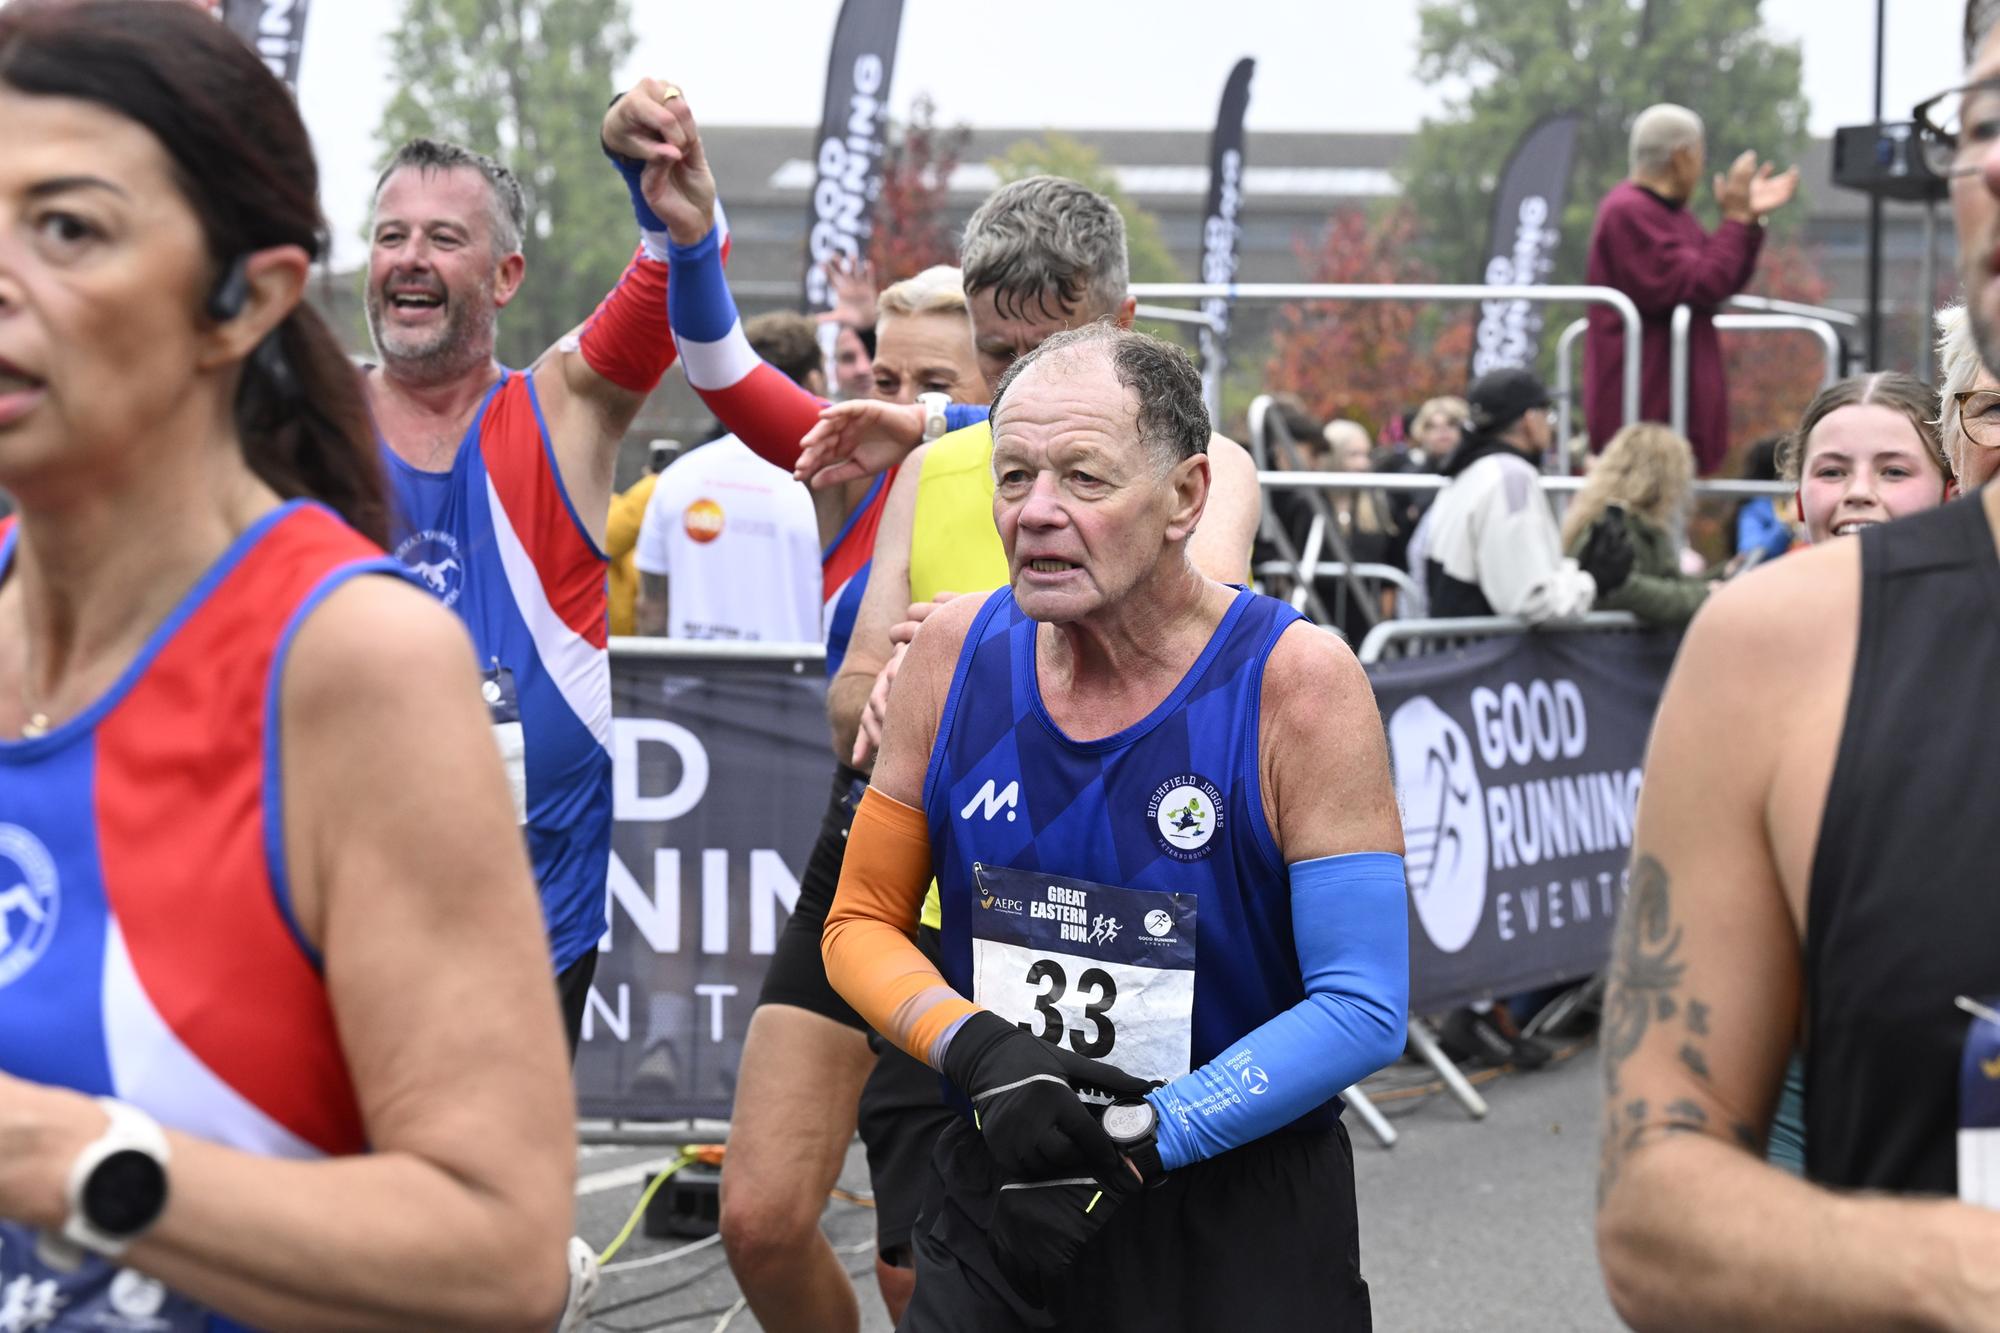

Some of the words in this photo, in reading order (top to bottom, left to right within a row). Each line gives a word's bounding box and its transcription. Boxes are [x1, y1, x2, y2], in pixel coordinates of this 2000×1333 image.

[1471, 678, 1587, 770] GOOD
[613, 717, 709, 821] D
[1147, 775, 1197, 818] BUSHFIELD
[1200, 782, 1225, 829] JOGGERS
[994, 897, 1023, 911] AEPG
[1047, 885, 1087, 907] GREAT
[1030, 901, 1087, 925] EASTERN
[1060, 923, 1087, 943] RUN
[581, 983, 738, 1043] NT
[1017, 958, 1118, 1059] 33
[1225, 1047, 1253, 1067] Triathlon
[1232, 1056, 1253, 1072] World
[1202, 1094, 1241, 1116] Duathlon
